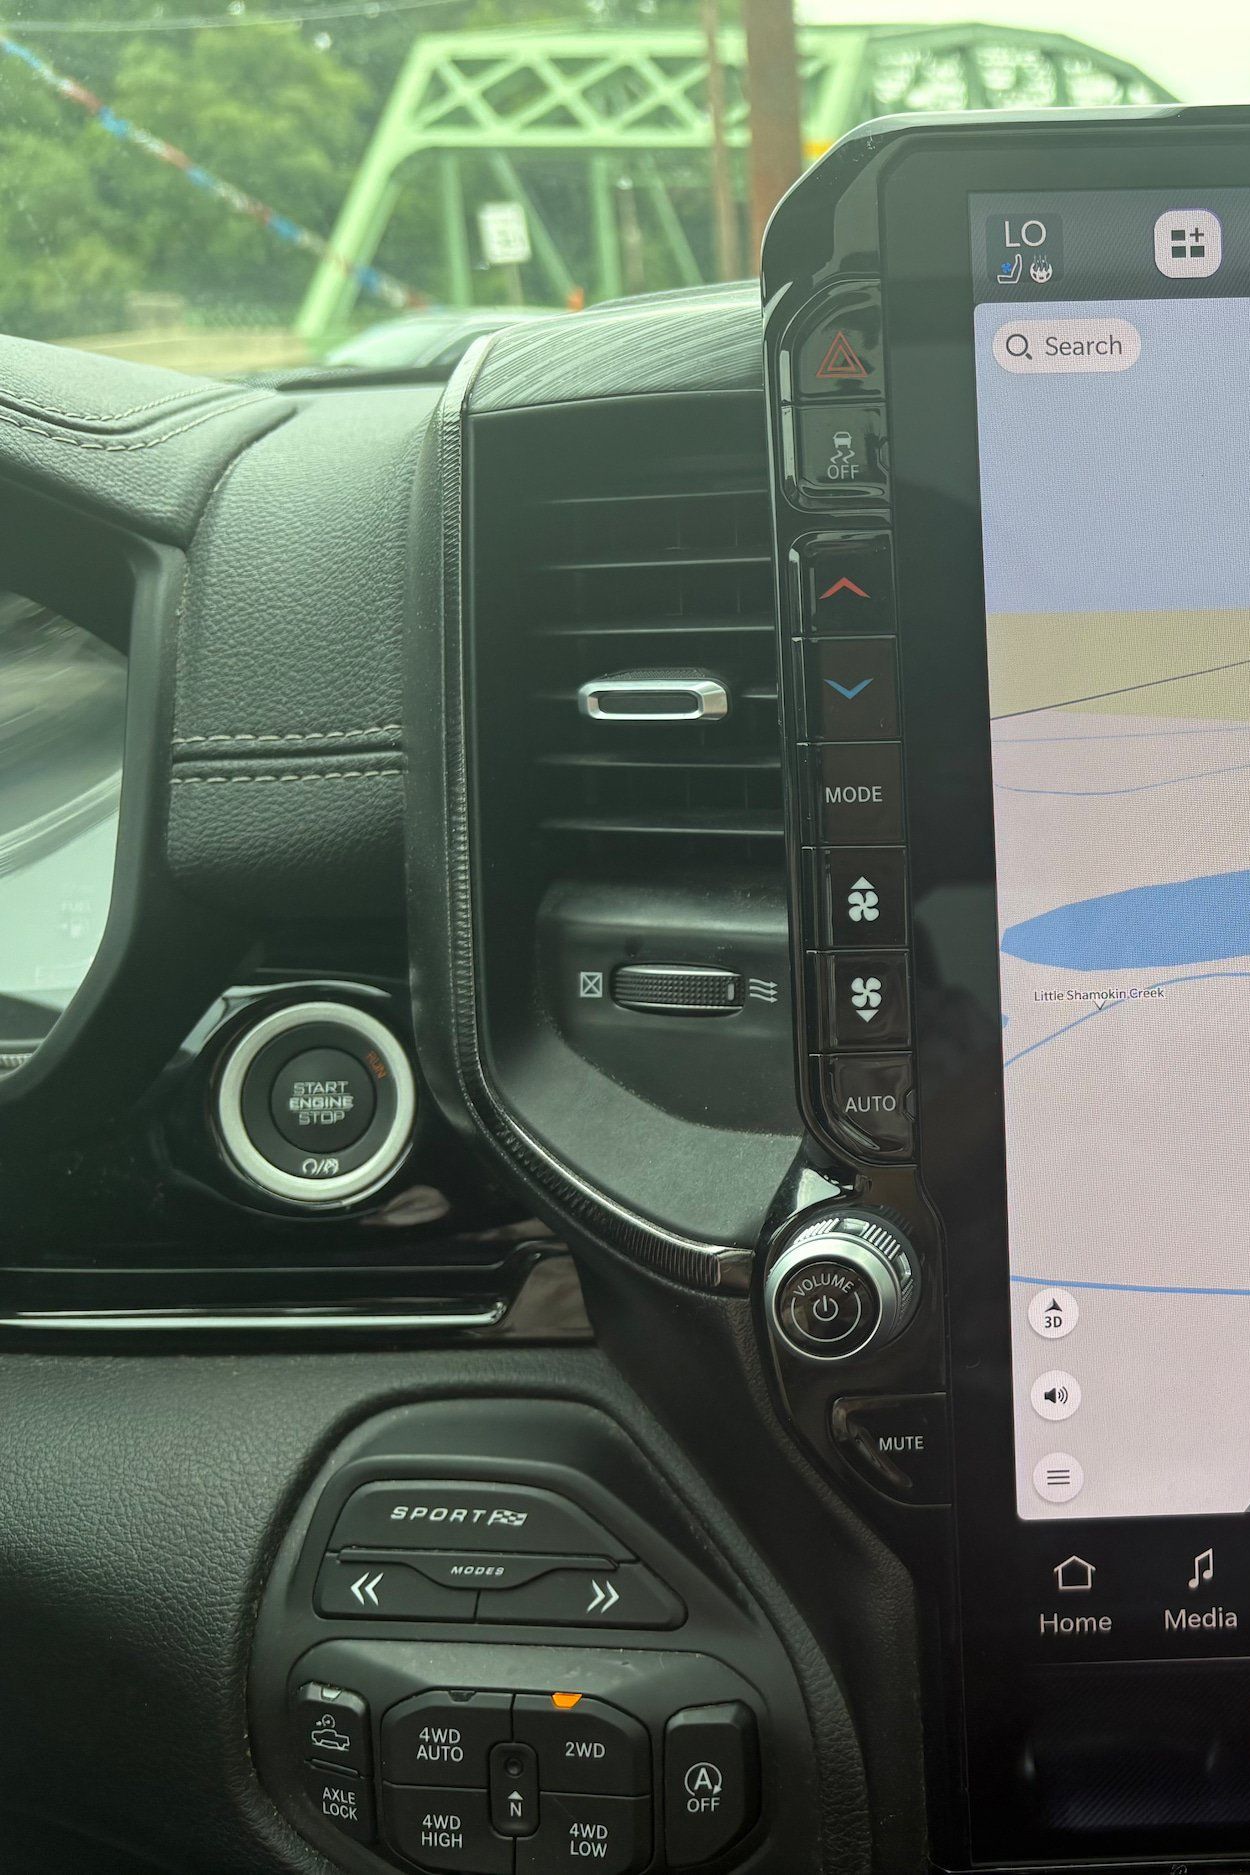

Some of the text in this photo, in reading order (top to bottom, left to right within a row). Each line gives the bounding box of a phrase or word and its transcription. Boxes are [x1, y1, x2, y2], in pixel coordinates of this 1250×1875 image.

[1004, 219, 1047, 248] LO
[1045, 335, 1124, 357] Search
[827, 464, 860, 480] OFF
[825, 786, 883, 803] MODE
[1034, 987, 1165, 1001] Little Shamokin Creek
[367, 1051, 388, 1079] RUN
[293, 1080, 349, 1095] START
[289, 1096, 354, 1110] ENGINE
[845, 1095, 896, 1113] AUTO
[298, 1110, 345, 1126] STOP
[793, 1273, 854, 1298] VOLUME
[1044, 1316, 1063, 1328] 3D
[878, 1436, 924, 1451] MUTE
[390, 1506, 487, 1524] SPORT
[450, 1565, 505, 1576] MODES
[1040, 1612, 1113, 1633] Home
[1163, 1607, 1239, 1630] Media
[418, 1726, 462, 1744] 4WD
[416, 1744, 464, 1763] AUTO
[564, 1741, 606, 1759] 2WD
[322, 1786, 356, 1805] AXLE
[322, 1801, 359, 1821] LOCK
[509, 1801, 522, 1817] N
[686, 1797, 721, 1813] OFF
[422, 1814, 462, 1830] 4WD
[569, 1822, 609, 1840] 4WD
[421, 1831, 463, 1848] HIGH
[569, 1840, 608, 1858] LOW
